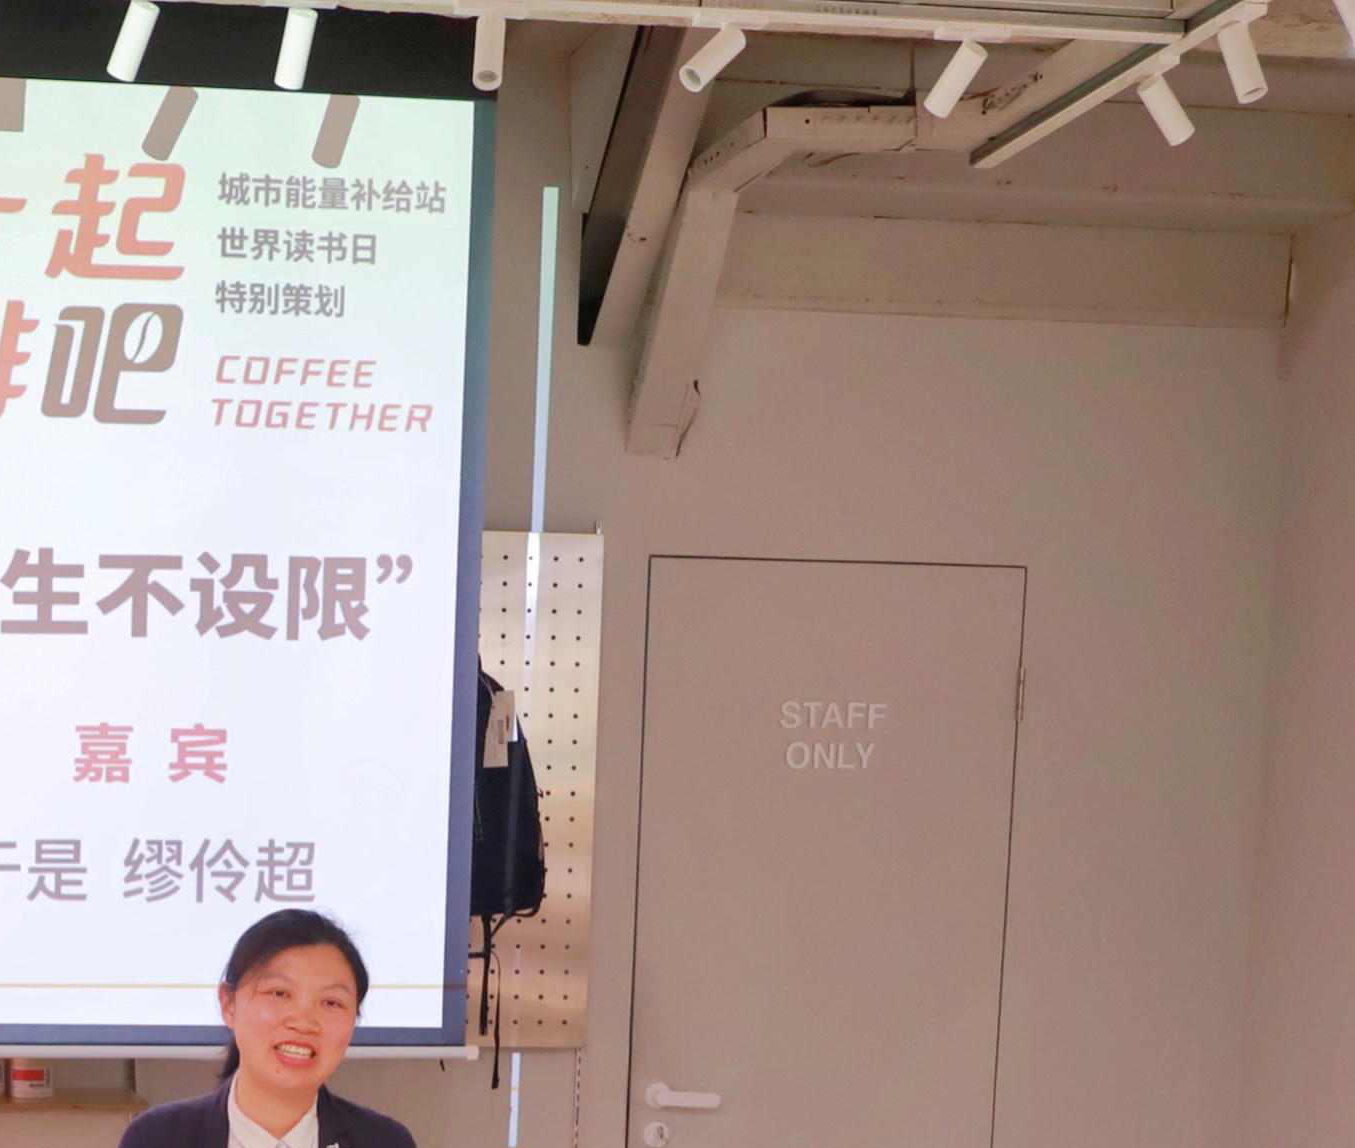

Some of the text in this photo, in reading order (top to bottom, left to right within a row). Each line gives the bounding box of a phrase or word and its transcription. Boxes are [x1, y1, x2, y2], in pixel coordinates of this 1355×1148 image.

[218, 172, 446, 213] 城市能量补给站
[217, 227, 376, 265] 世界读书日
[215, 280, 345, 318] 特别策划
[216, 356, 376, 388] COFFEE
[212, 399, 432, 432] TOGETHER
[781, 701, 887, 729] STAFF
[784, 741, 875, 769] ONLY
[123, 838, 315, 903] 缪伶超
